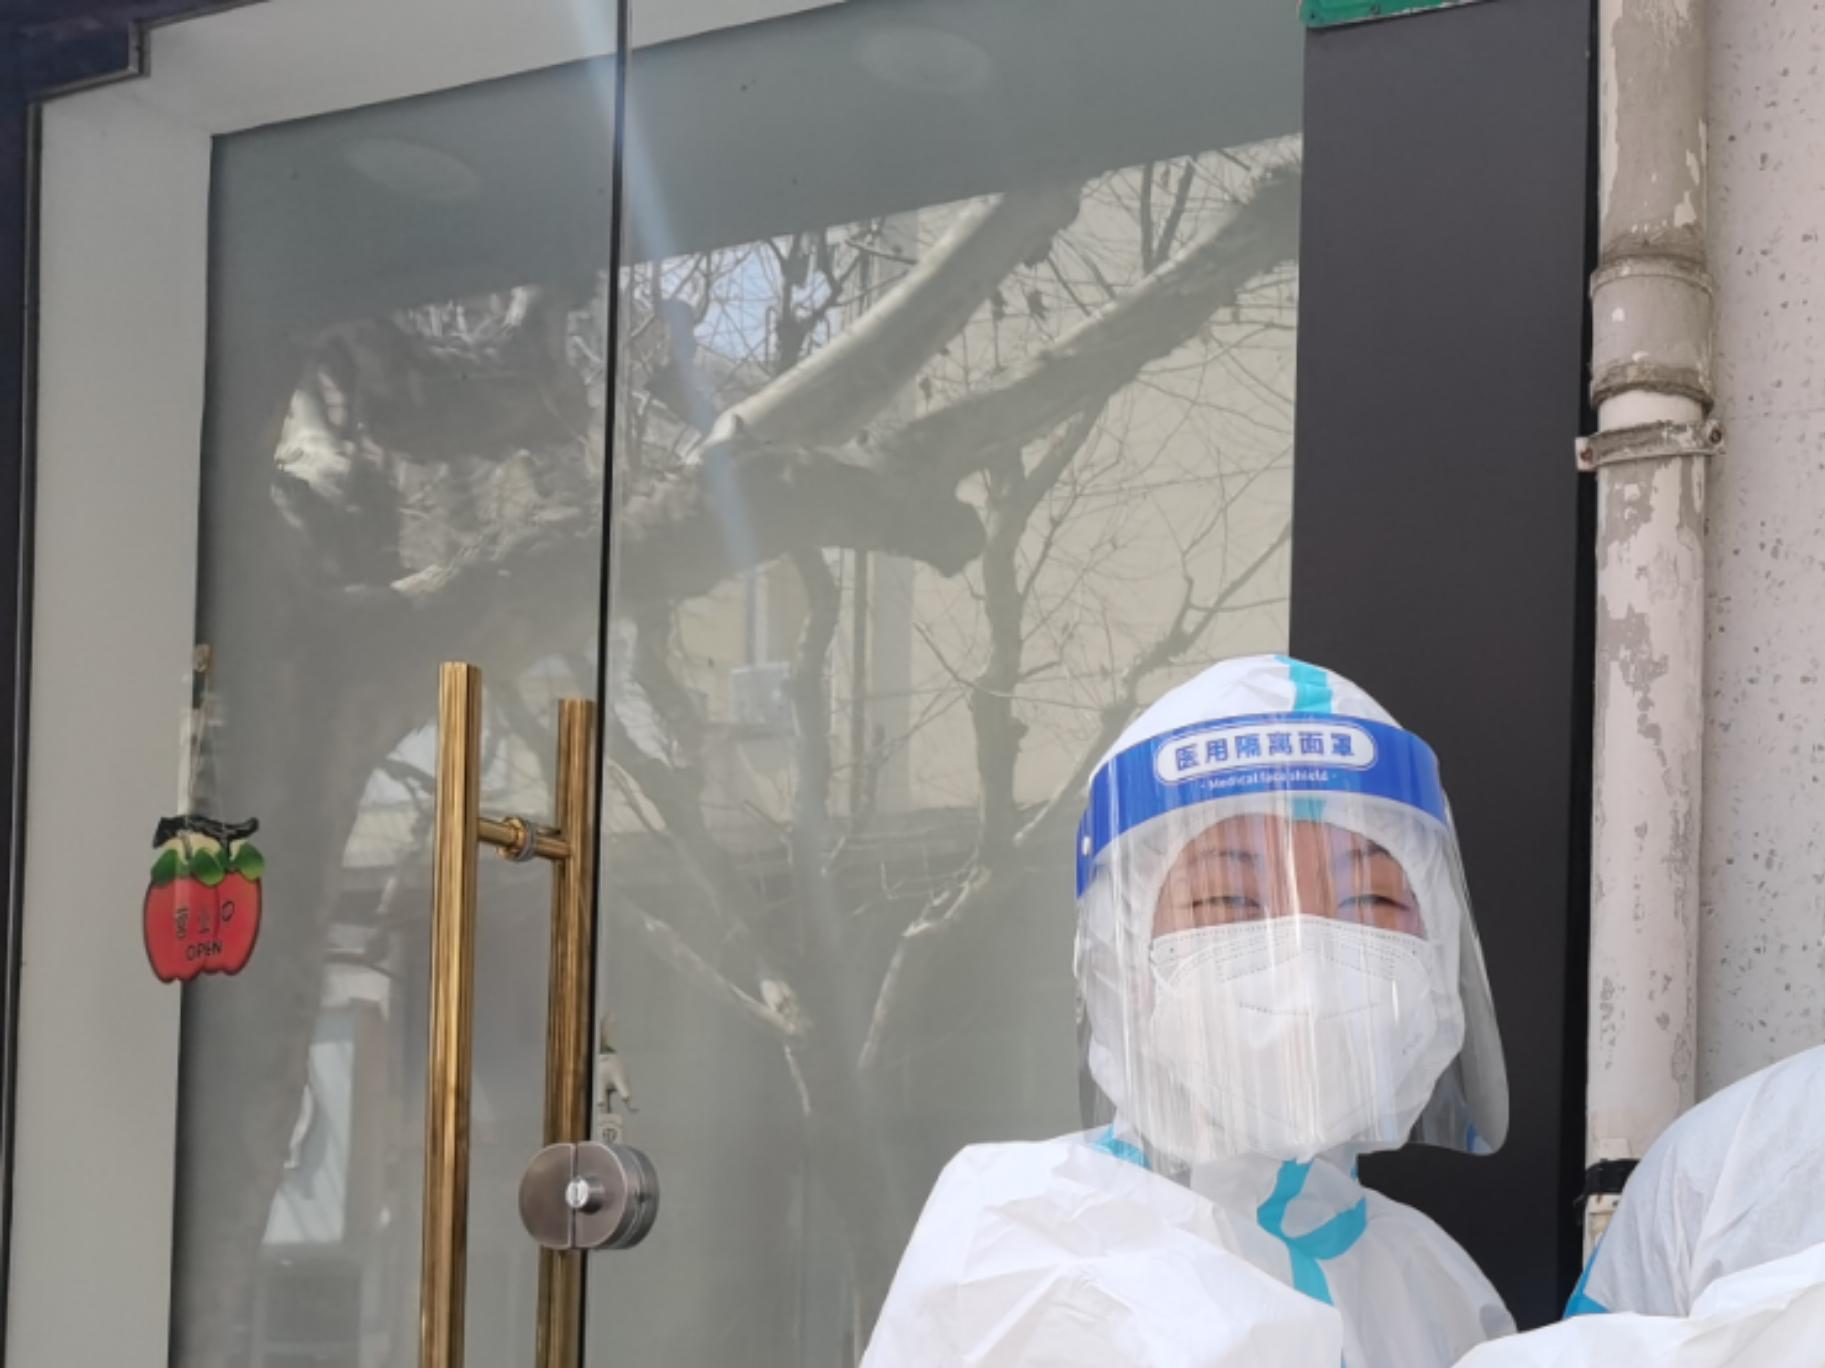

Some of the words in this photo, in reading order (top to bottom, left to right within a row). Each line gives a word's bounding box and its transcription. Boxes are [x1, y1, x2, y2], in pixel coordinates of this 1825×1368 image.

[1174, 731, 1356, 772] 医用隔离面罩
[1208, 772, 1259, 790] Medical
